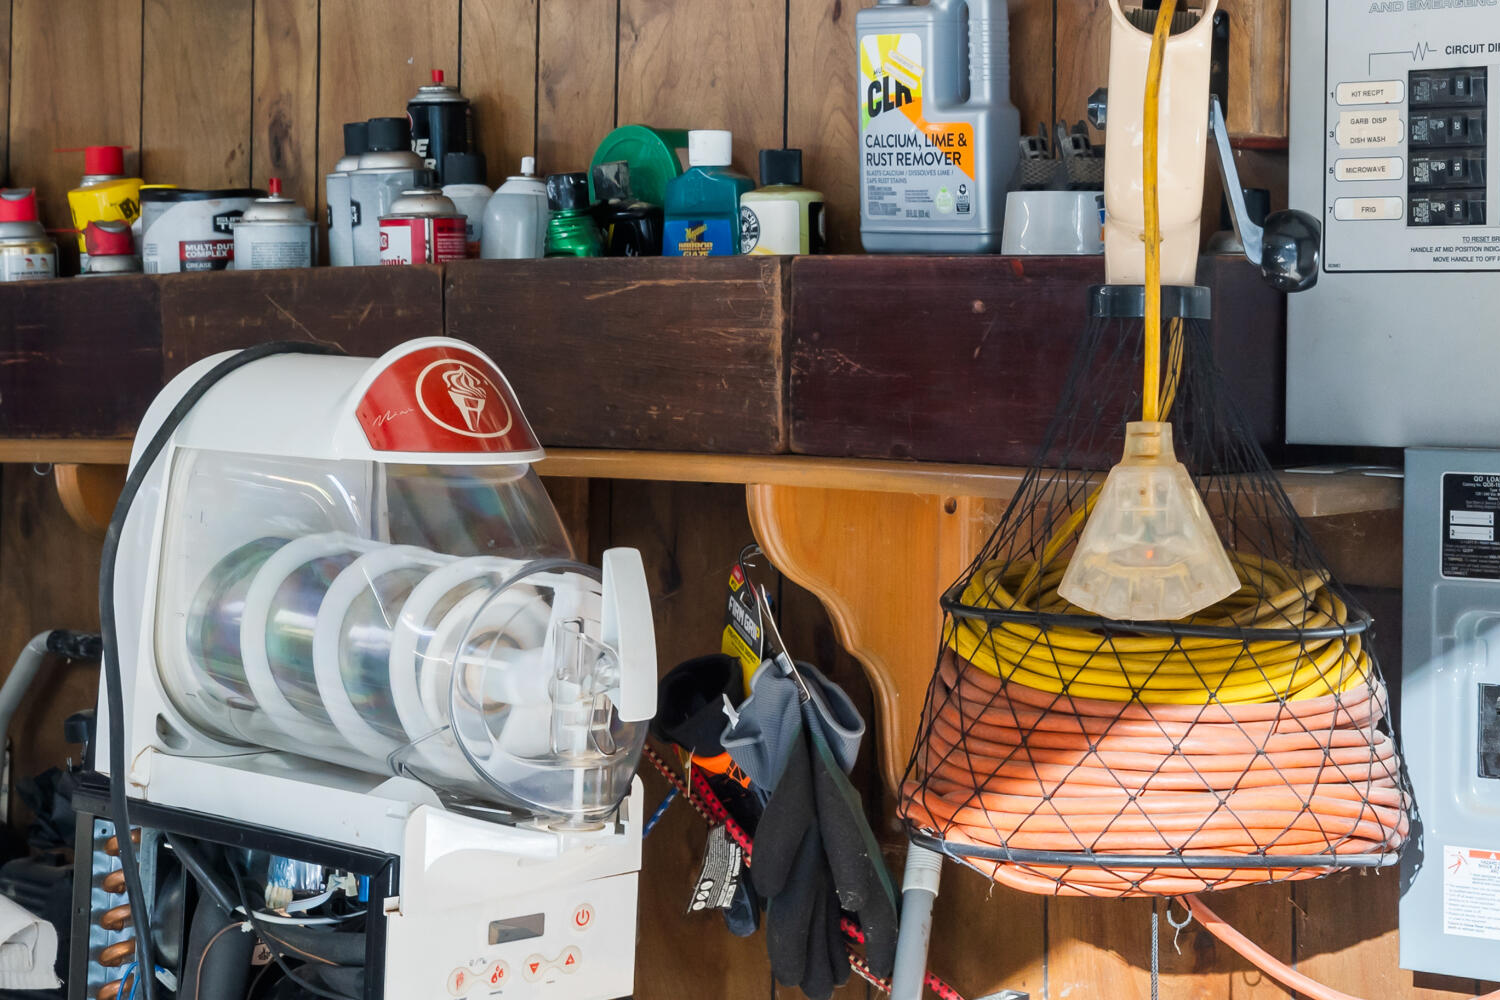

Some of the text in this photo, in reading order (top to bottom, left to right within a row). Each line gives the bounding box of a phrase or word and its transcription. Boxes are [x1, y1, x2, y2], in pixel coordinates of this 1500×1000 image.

[1369, 1, 1404, 14] AND
[1445, 43, 1485, 55] CIRCUIT
[1362, 89, 1384, 97] RECPT
[866, 132, 968, 150] CALCIUM, LIME &
[866, 151, 962, 166] RUST REMOVER
[185, 250, 228, 258] COMPLEX
[728, 595, 760, 640] FIRM GRIP
